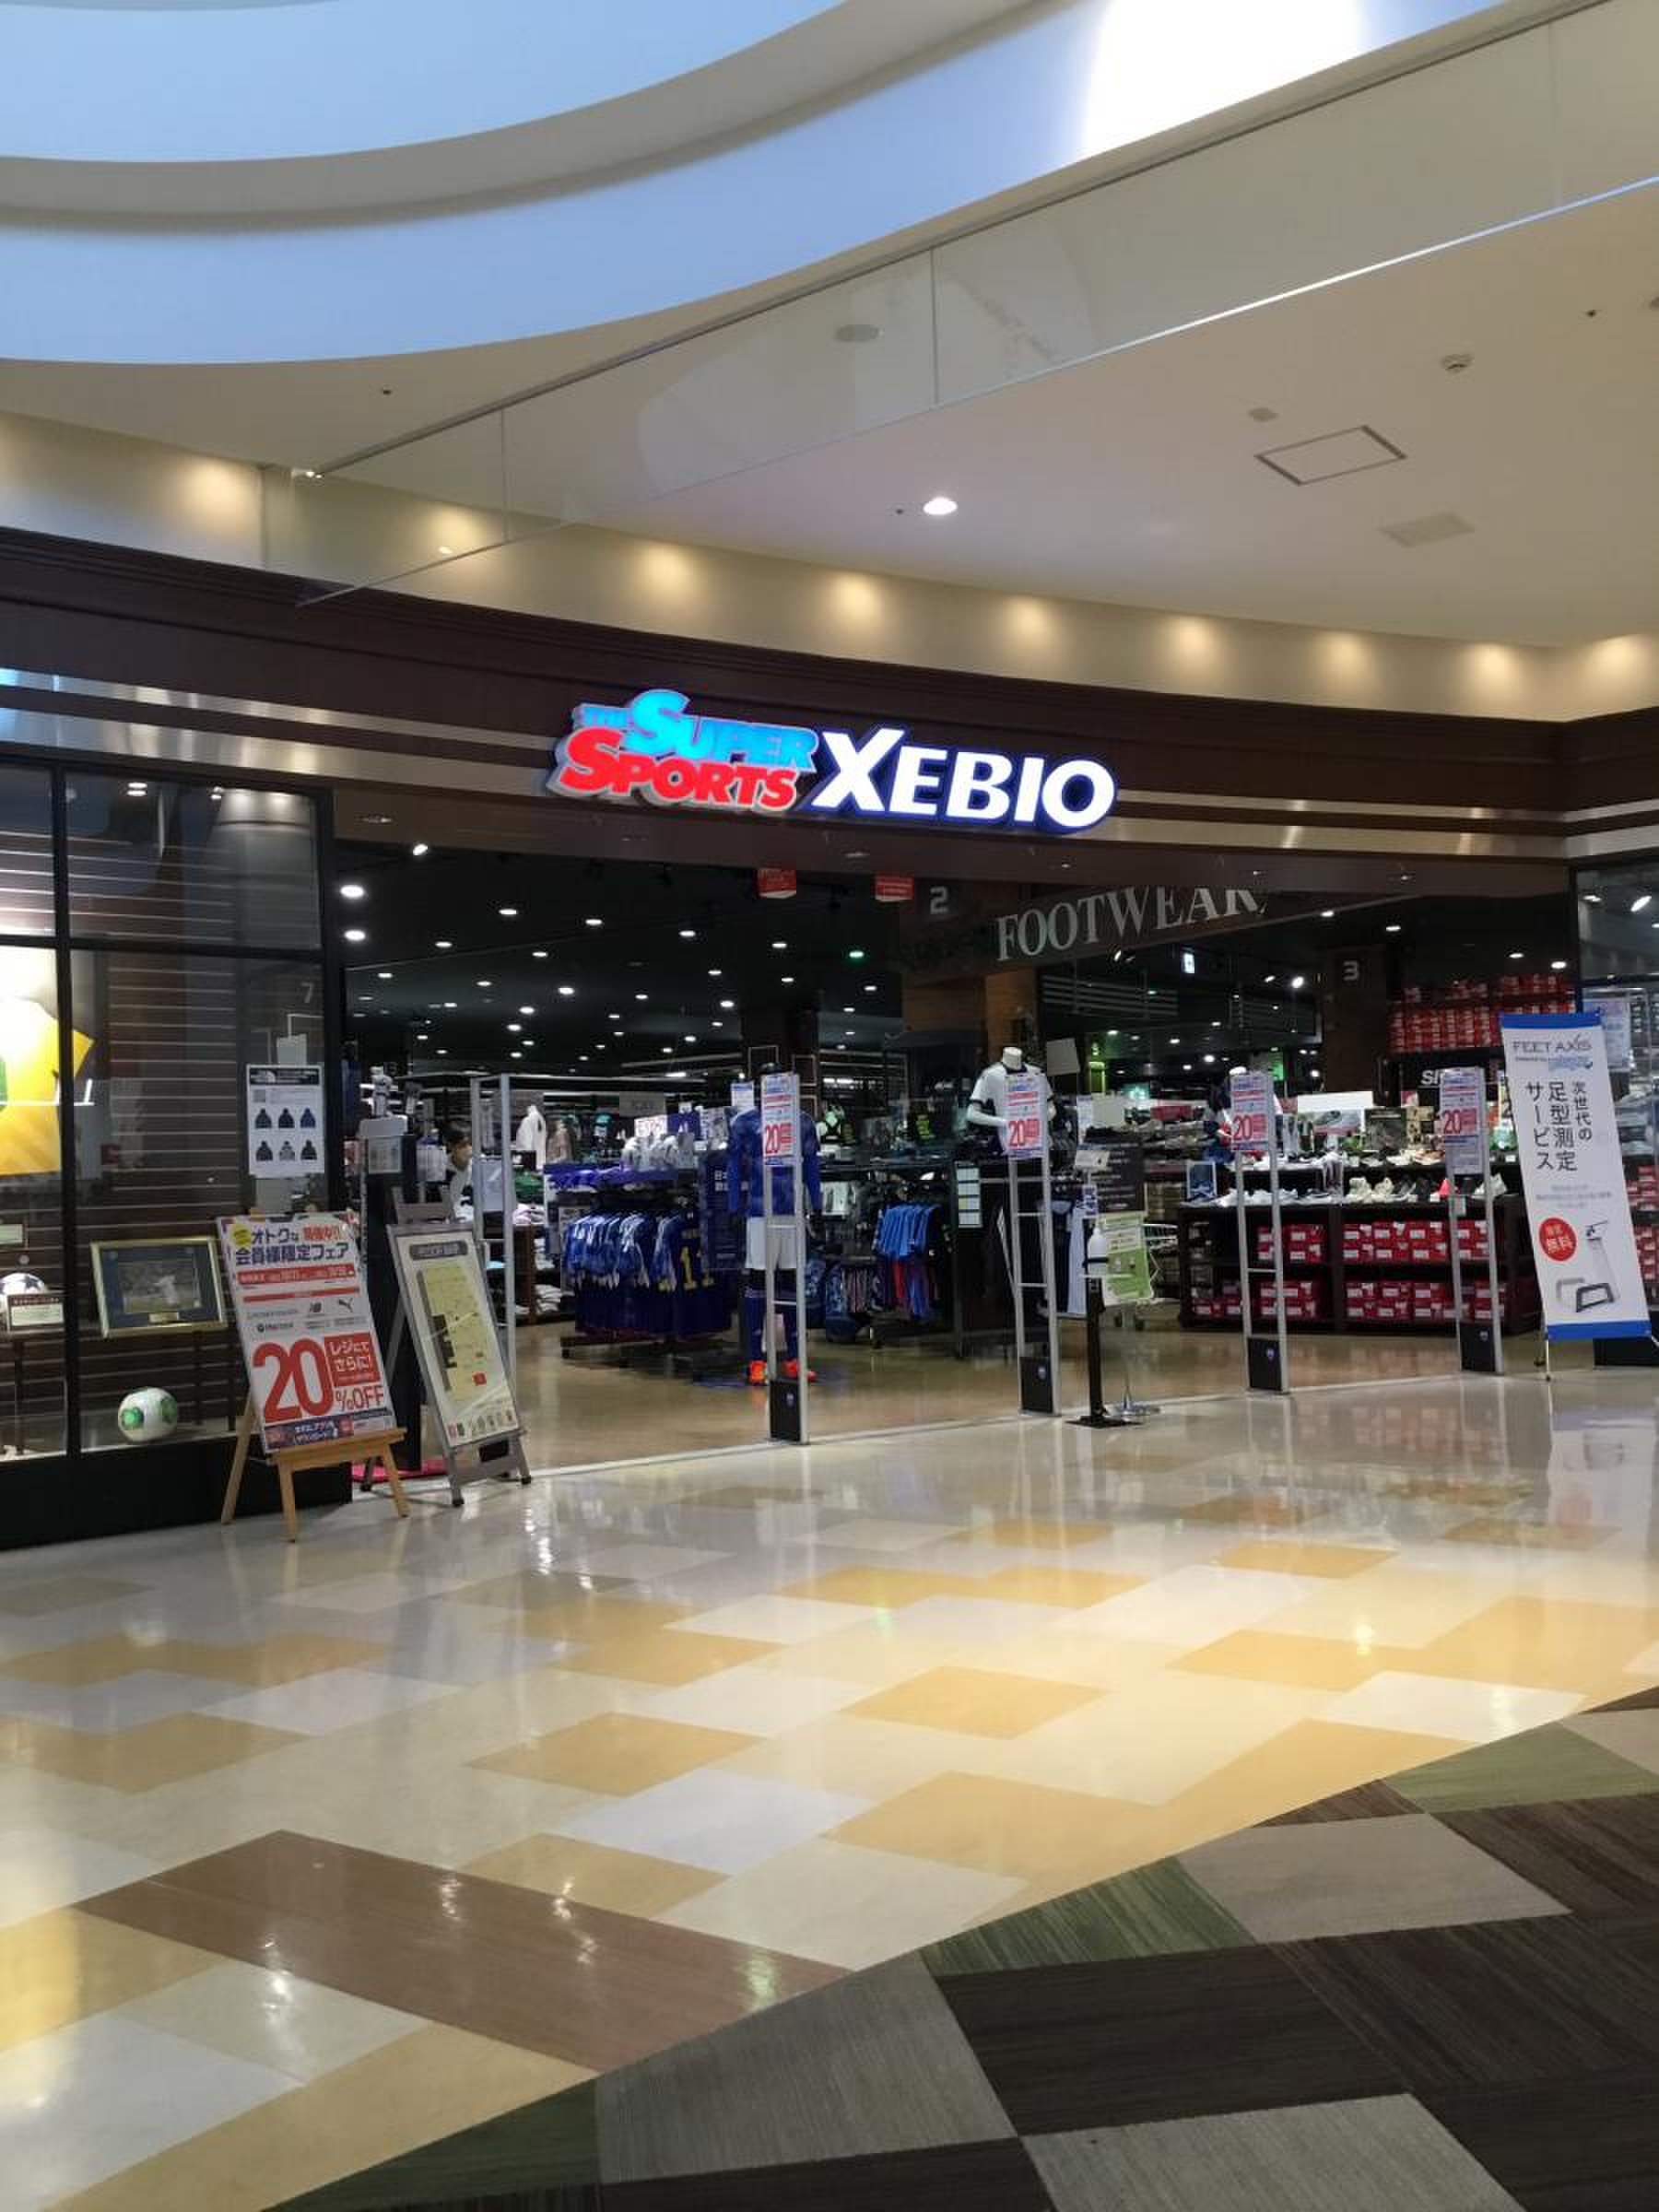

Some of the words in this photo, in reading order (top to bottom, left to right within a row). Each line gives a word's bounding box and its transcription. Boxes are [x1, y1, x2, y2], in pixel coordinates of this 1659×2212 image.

[624, 689, 817, 769] SUPER
[559, 728, 797, 808] SPORTS
[811, 728, 1115, 828] XEBIO
[930, 887, 947, 914] 2
[1343, 960, 1359, 981] 3
[1008, 1119, 1025, 1147] 20
[1233, 1114, 1253, 1141] 20
[1444, 1109, 1461, 1135] 20
[1525, 1081, 1554, 1171] サービス
[1548, 1081, 1579, 1171] 足型測定
[1571, 1081, 1593, 1142] 次世代の
[236, 1242, 349, 1265] 会員様限定フェア
[253, 1338, 335, 1424] 20
